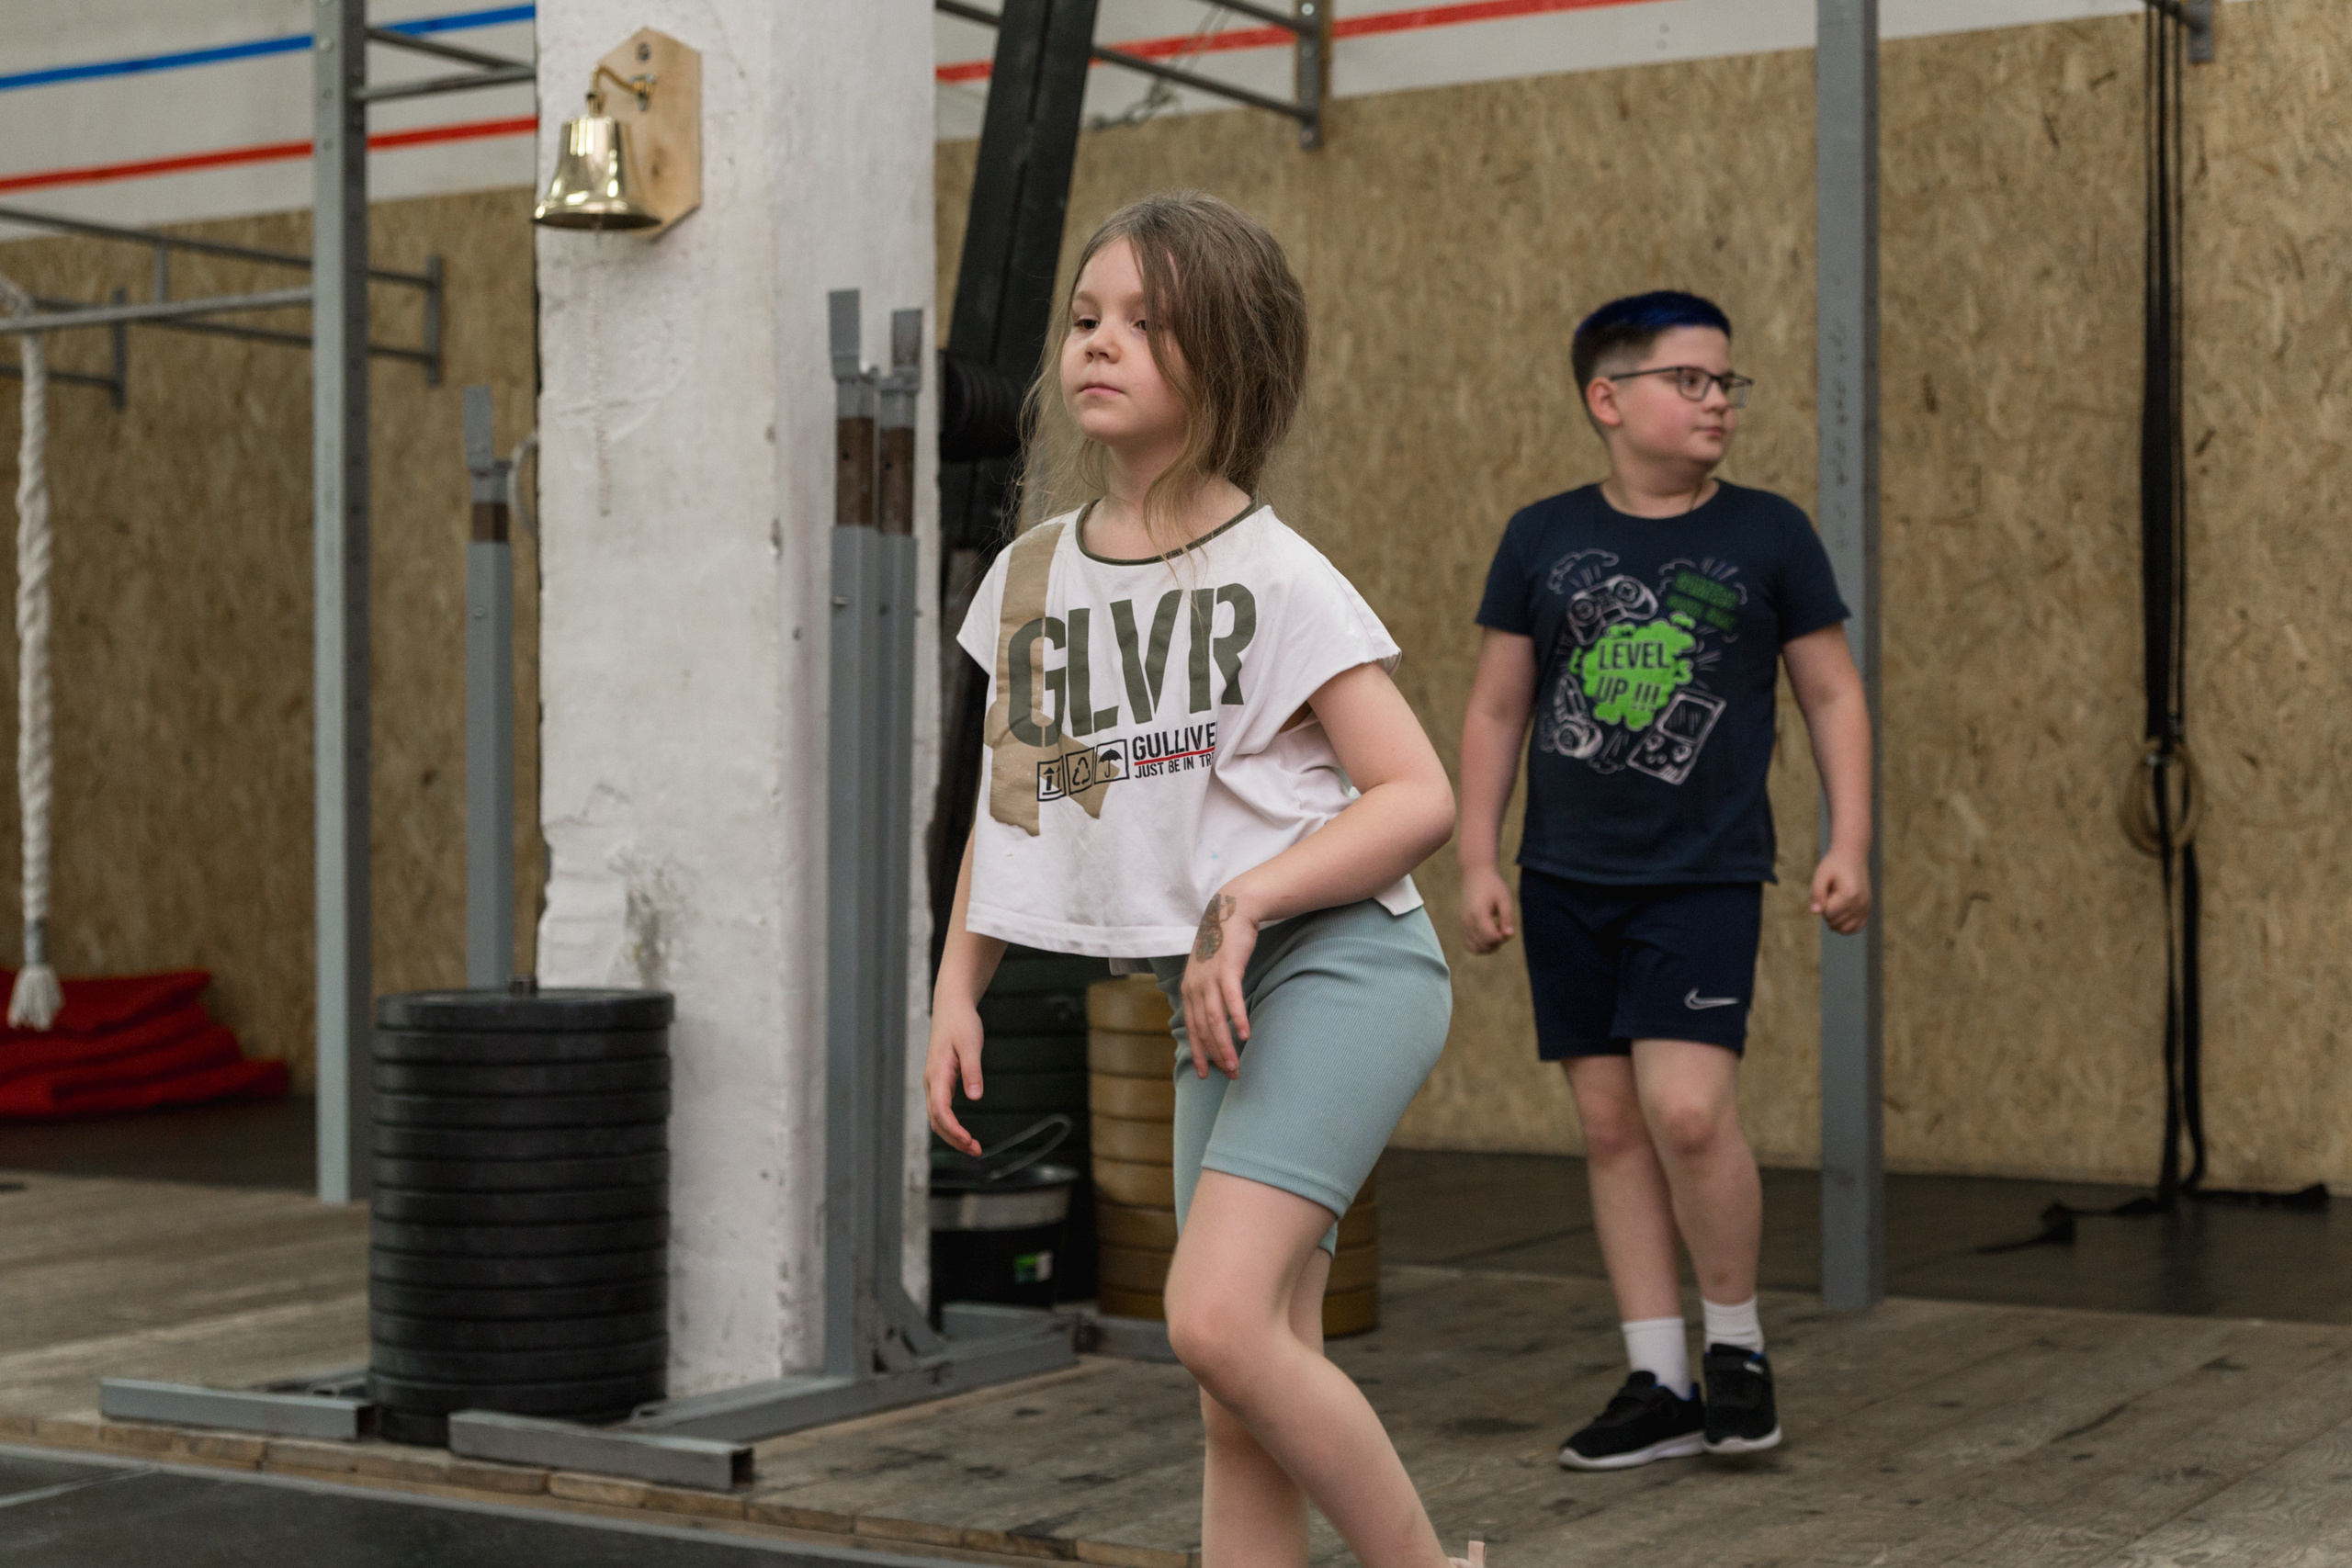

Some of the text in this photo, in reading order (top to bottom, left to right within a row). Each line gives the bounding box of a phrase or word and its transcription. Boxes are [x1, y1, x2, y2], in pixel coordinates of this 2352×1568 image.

[1008, 582, 1257, 748] GLVR
[1599, 641, 1670, 670] LEVEL
[1595, 676, 1661, 711] UP !!!
[1132, 720, 1218, 761] GULLIVE
[1134, 762, 1164, 778] JUST
[1169, 759, 1181, 773] BE
[1183, 756, 1194, 771] IN
